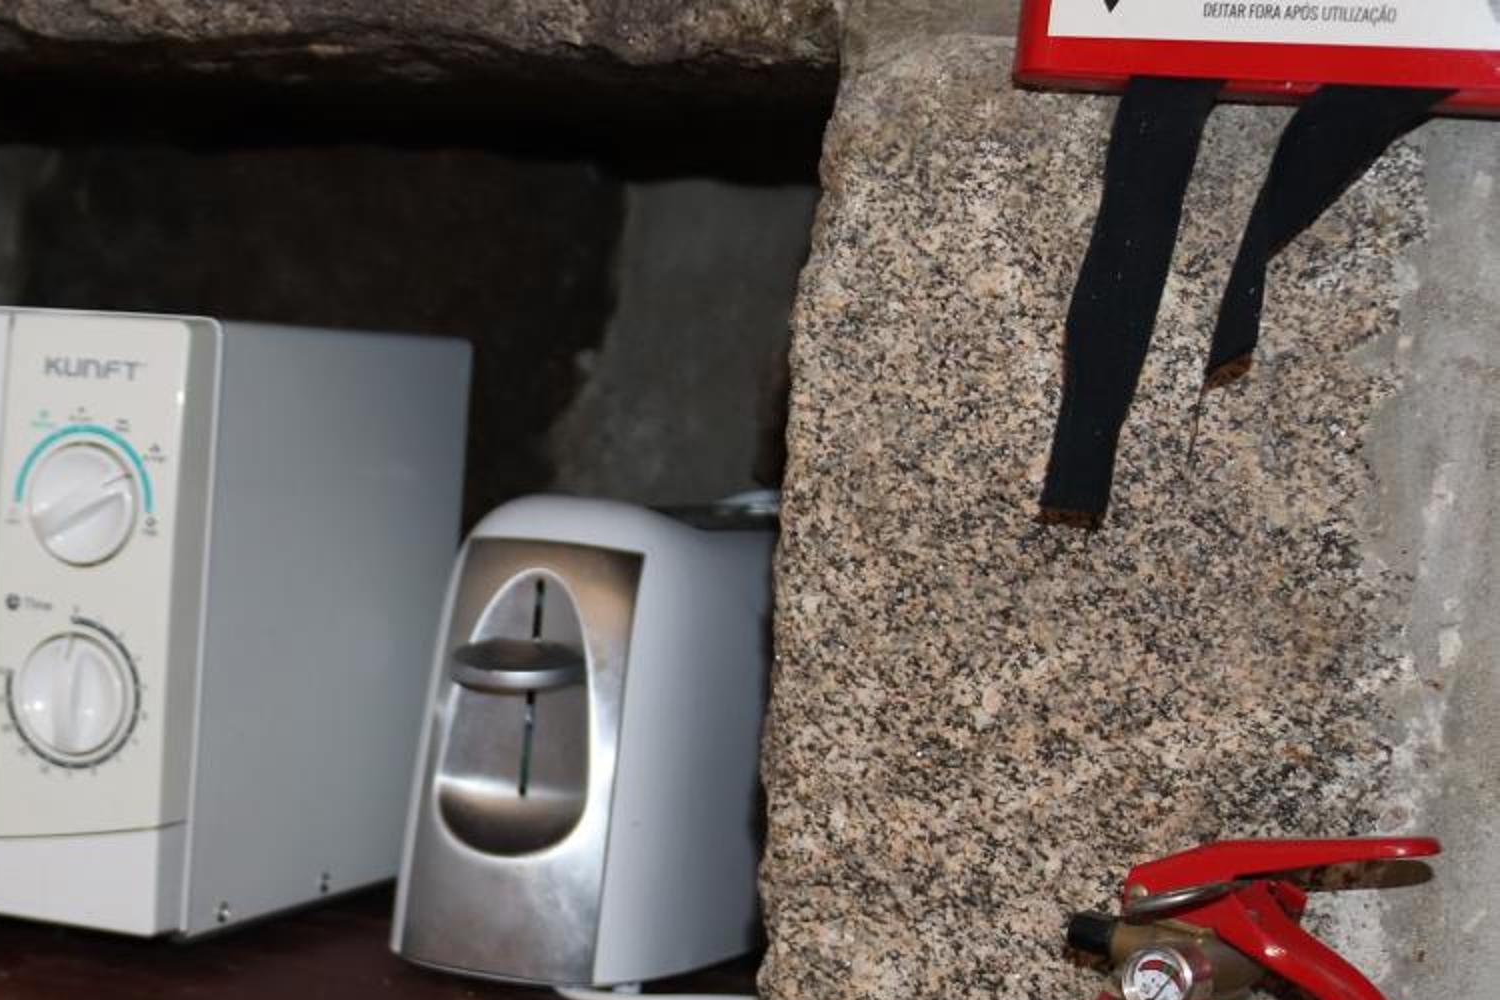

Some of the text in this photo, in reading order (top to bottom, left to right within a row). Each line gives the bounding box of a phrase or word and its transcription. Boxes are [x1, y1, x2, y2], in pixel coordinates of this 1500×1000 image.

[1202, 2, 1397, 27] DEITAR FORA APÓS UTILIZAÇÃO
